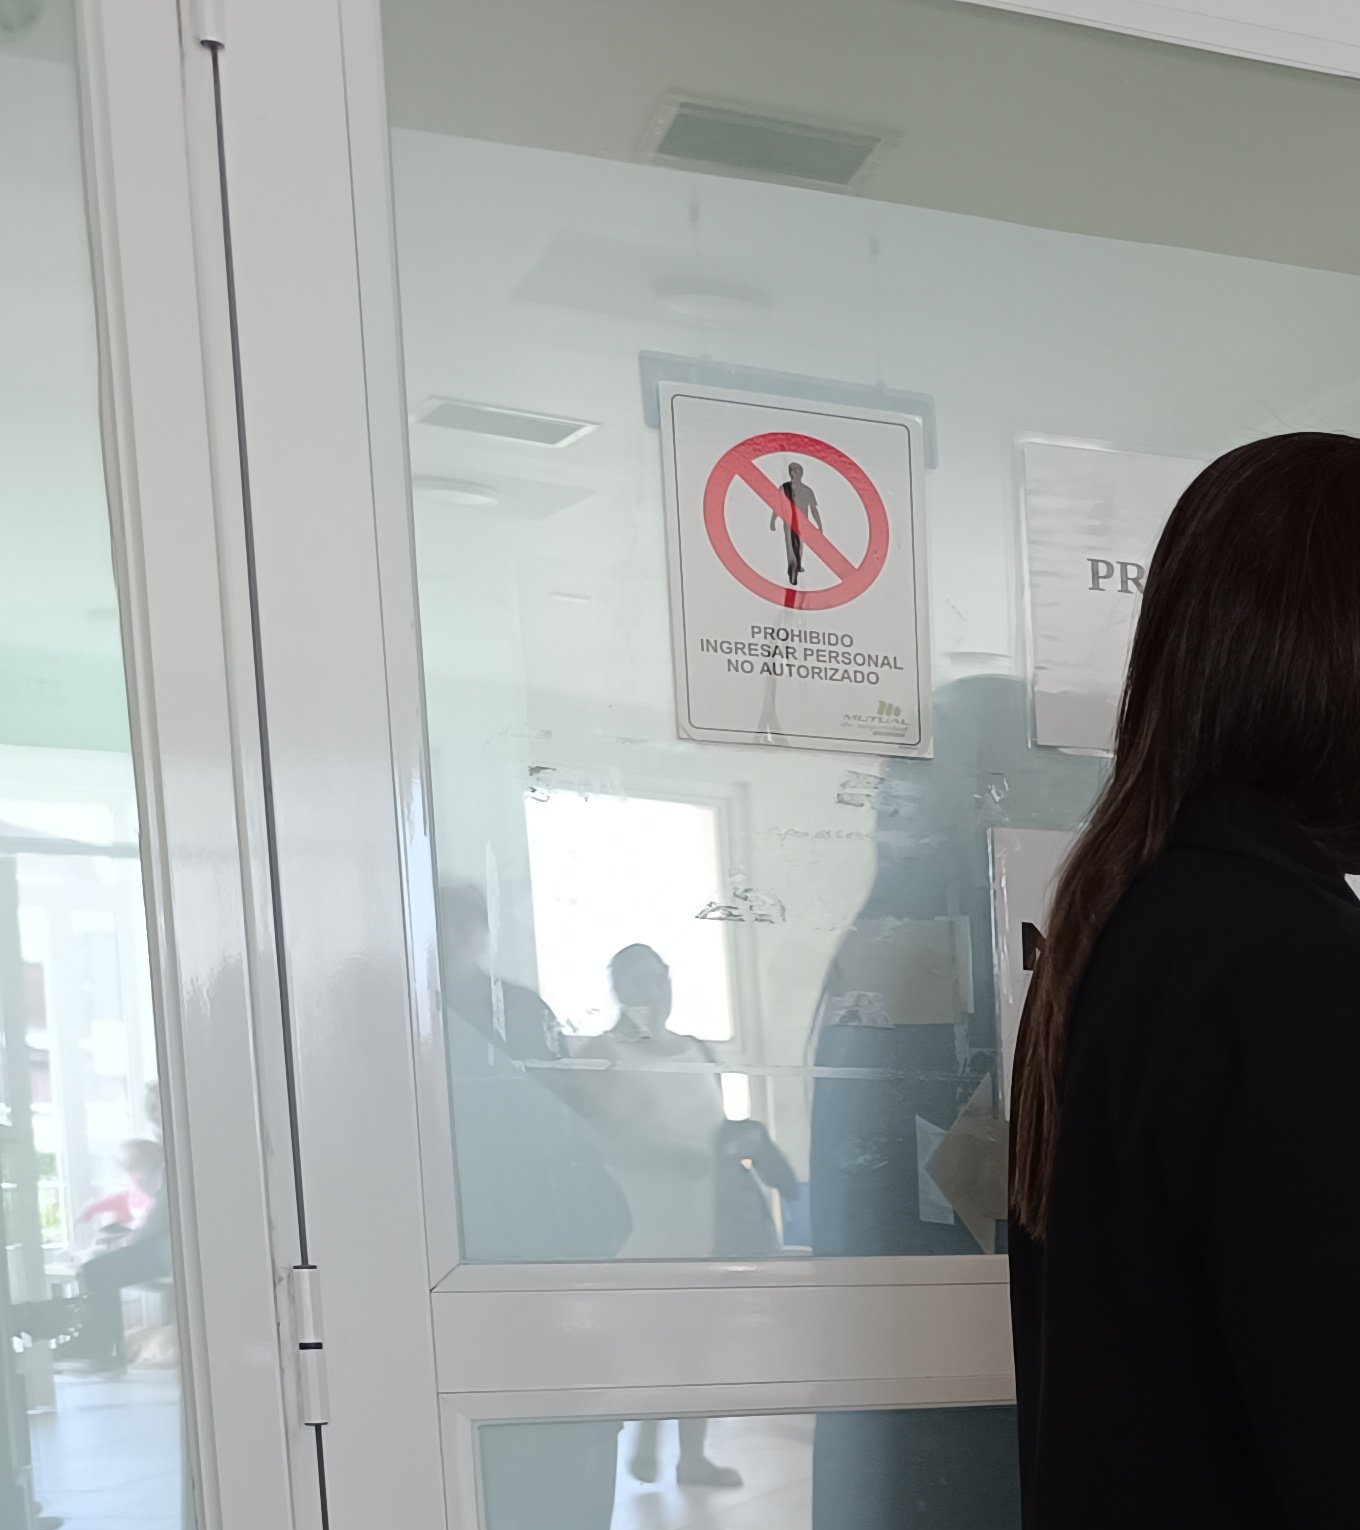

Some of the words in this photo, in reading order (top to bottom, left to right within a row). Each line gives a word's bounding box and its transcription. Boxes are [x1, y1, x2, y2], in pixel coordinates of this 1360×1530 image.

[1086, 558, 1146, 595] PR
[750, 625, 854, 648] PROHIBIDO
[700, 638, 798, 660] INGRESAR
[803, 647, 904, 671] PERSONAL
[726, 658, 754, 674] NO
[759, 661, 880, 685] AUTORIZADO
[842, 713, 911, 726] MUTUAL
